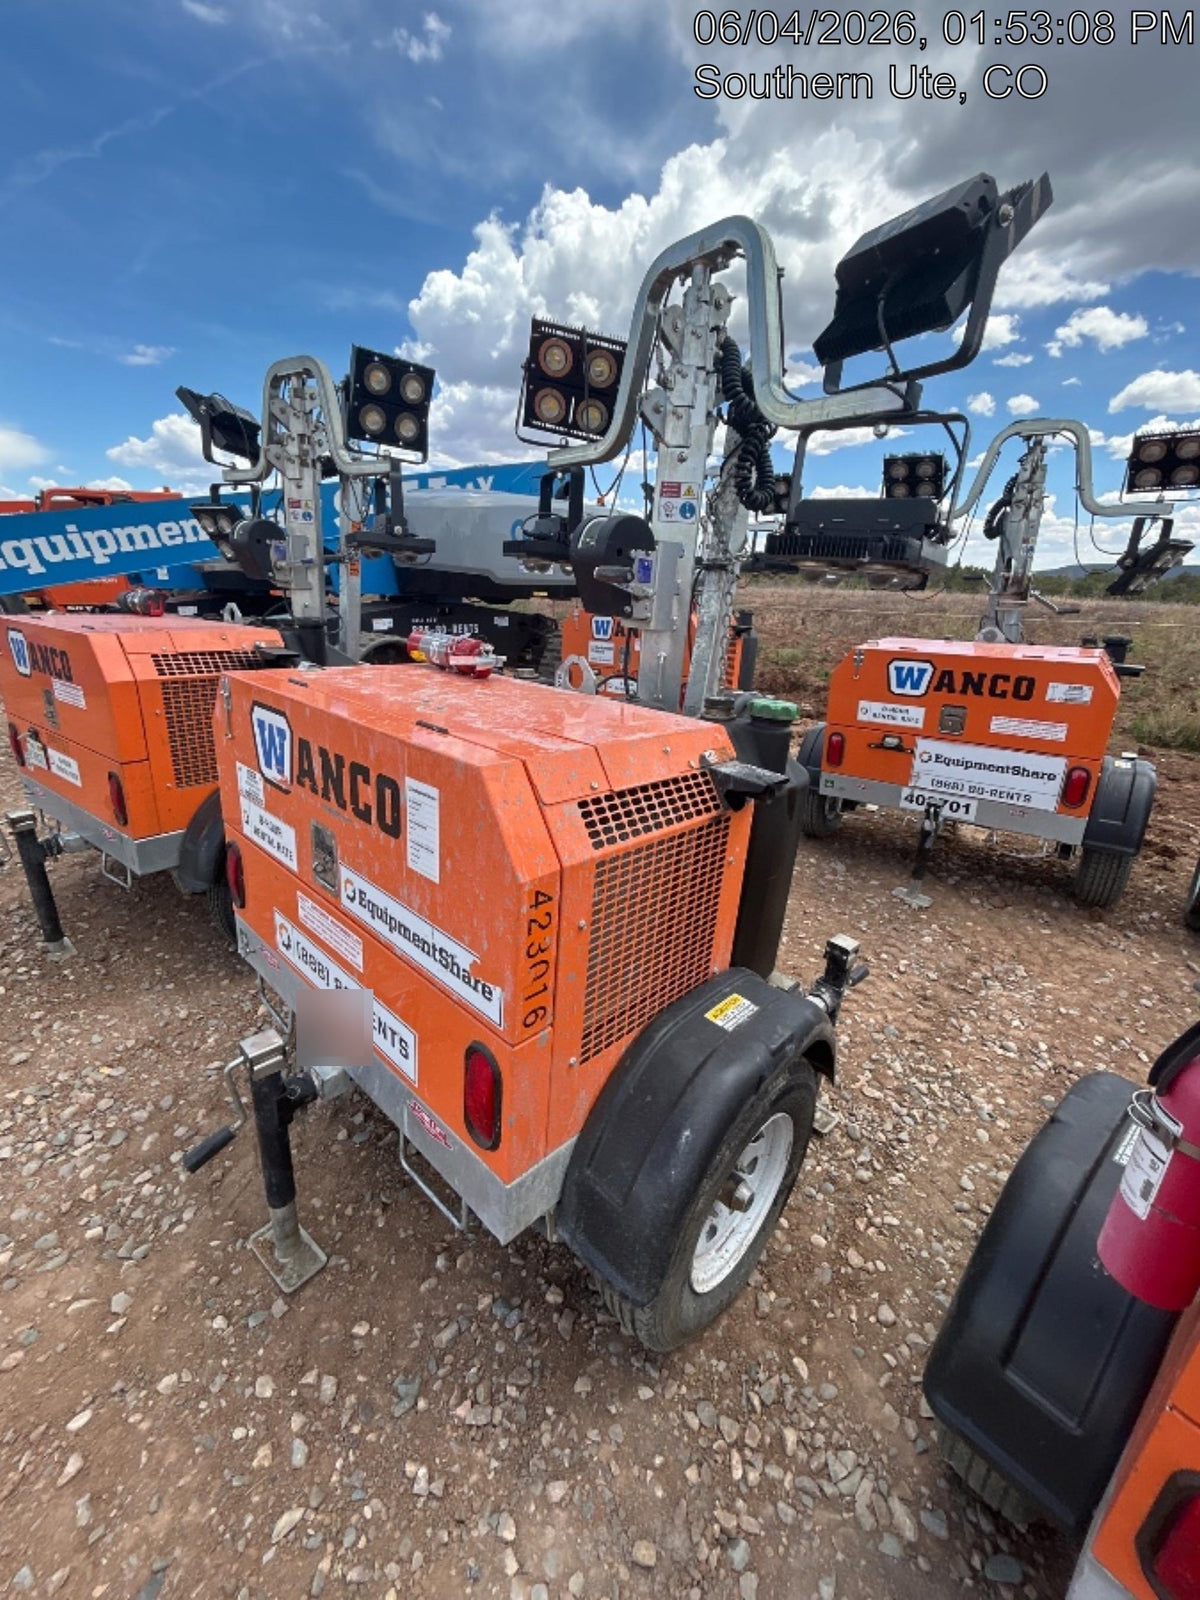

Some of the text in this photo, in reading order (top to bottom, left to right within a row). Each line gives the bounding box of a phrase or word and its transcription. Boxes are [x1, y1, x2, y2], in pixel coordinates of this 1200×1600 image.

[0, 518, 210, 575] quipmen
[9, 634, 73, 682] WANCO
[892, 664, 1036, 701] WANCO
[256, 716, 402, 839] WANCO
[933, 753, 1057, 782] EquipmentShare
[358, 888, 494, 1003] EquipmentShare
